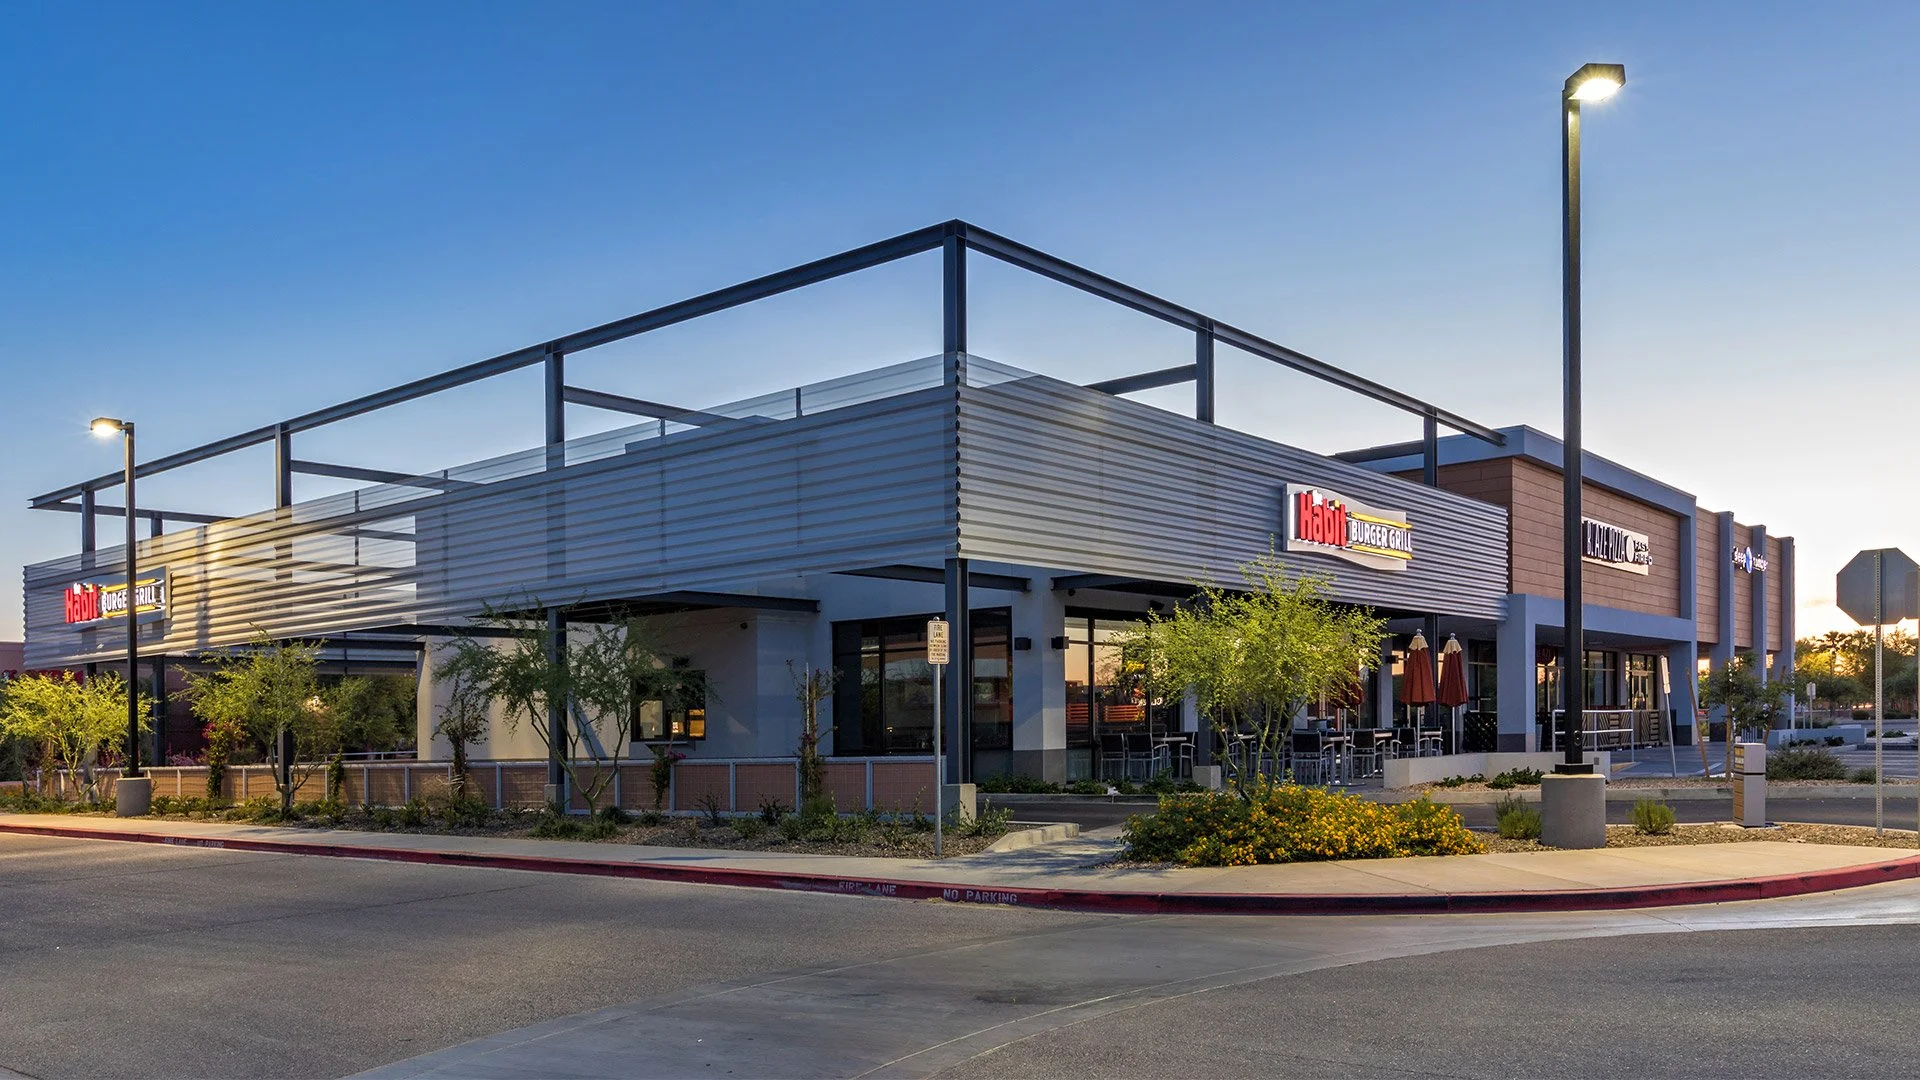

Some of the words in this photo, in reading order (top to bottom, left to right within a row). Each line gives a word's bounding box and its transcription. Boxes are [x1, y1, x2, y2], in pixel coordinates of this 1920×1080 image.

[1300, 491, 1347, 547] Habit
[1351, 520, 1388, 547] BURGER
[1389, 529, 1412, 552] GRILL
[64, 583, 99, 623] Habit
[101, 591, 127, 611] BURGE
[838, 881, 862, 892] FIRE
[943, 888, 958, 899] NO
[966, 889, 1018, 903] PARKING
